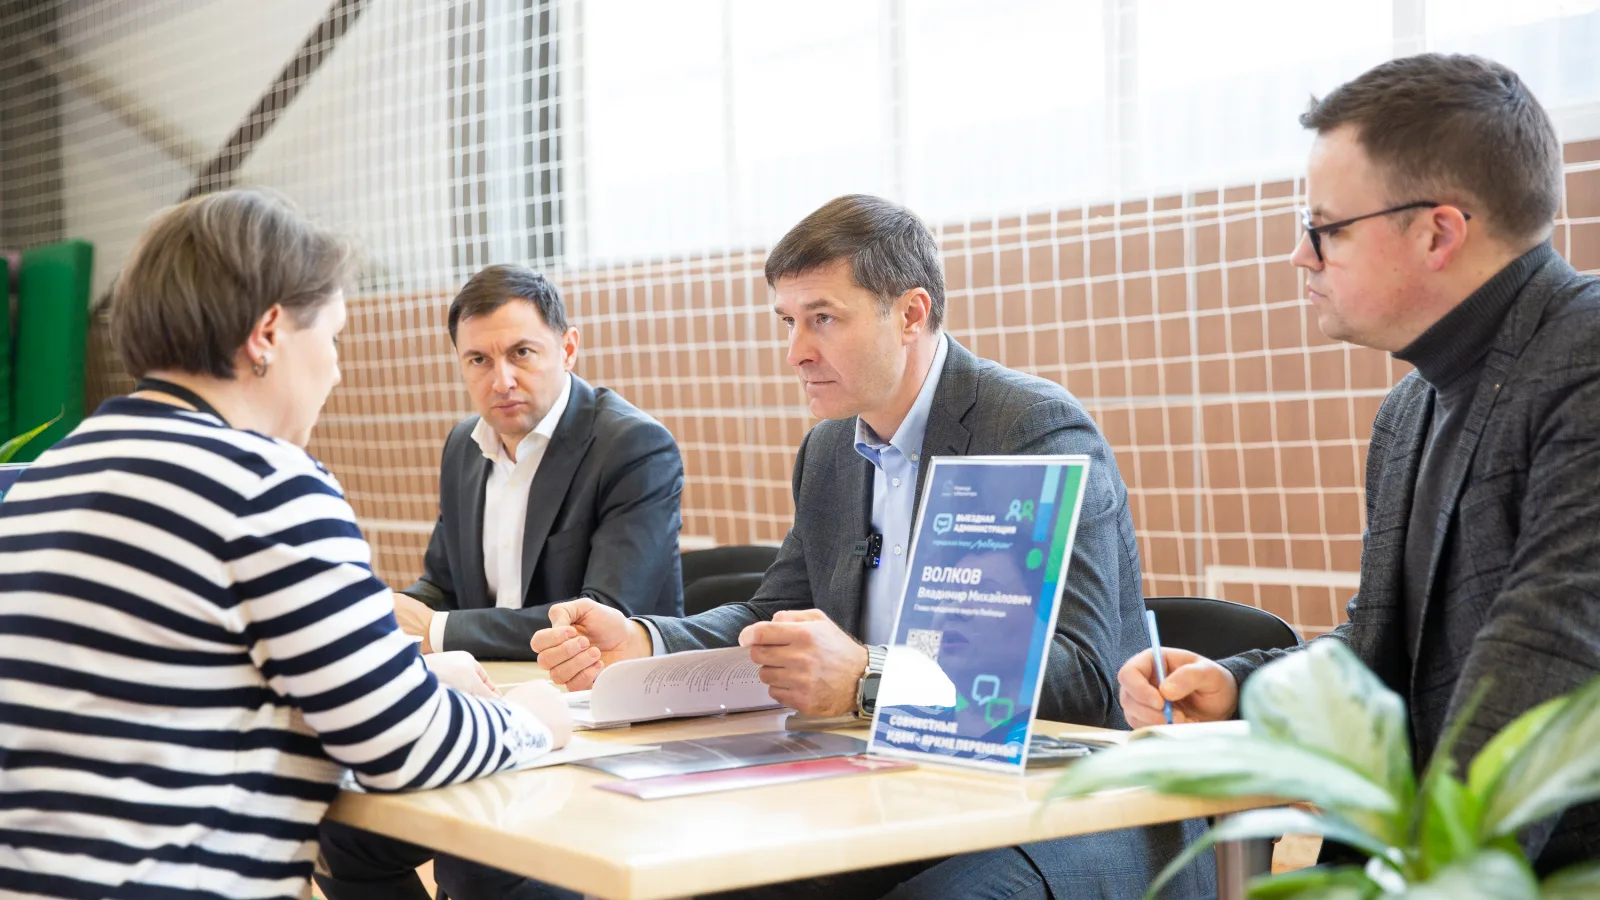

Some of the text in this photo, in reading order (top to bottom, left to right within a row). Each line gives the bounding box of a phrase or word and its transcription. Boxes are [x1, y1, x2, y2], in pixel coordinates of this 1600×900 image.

[953, 524, 1017, 535] АДМИНИСТРАЦИЯ
[921, 566, 982, 585] ВОЛКОВ
[917, 586, 1032, 606] Владимир Михайлович
[889, 714, 958, 734] СОВМЕСТНЫЕ
